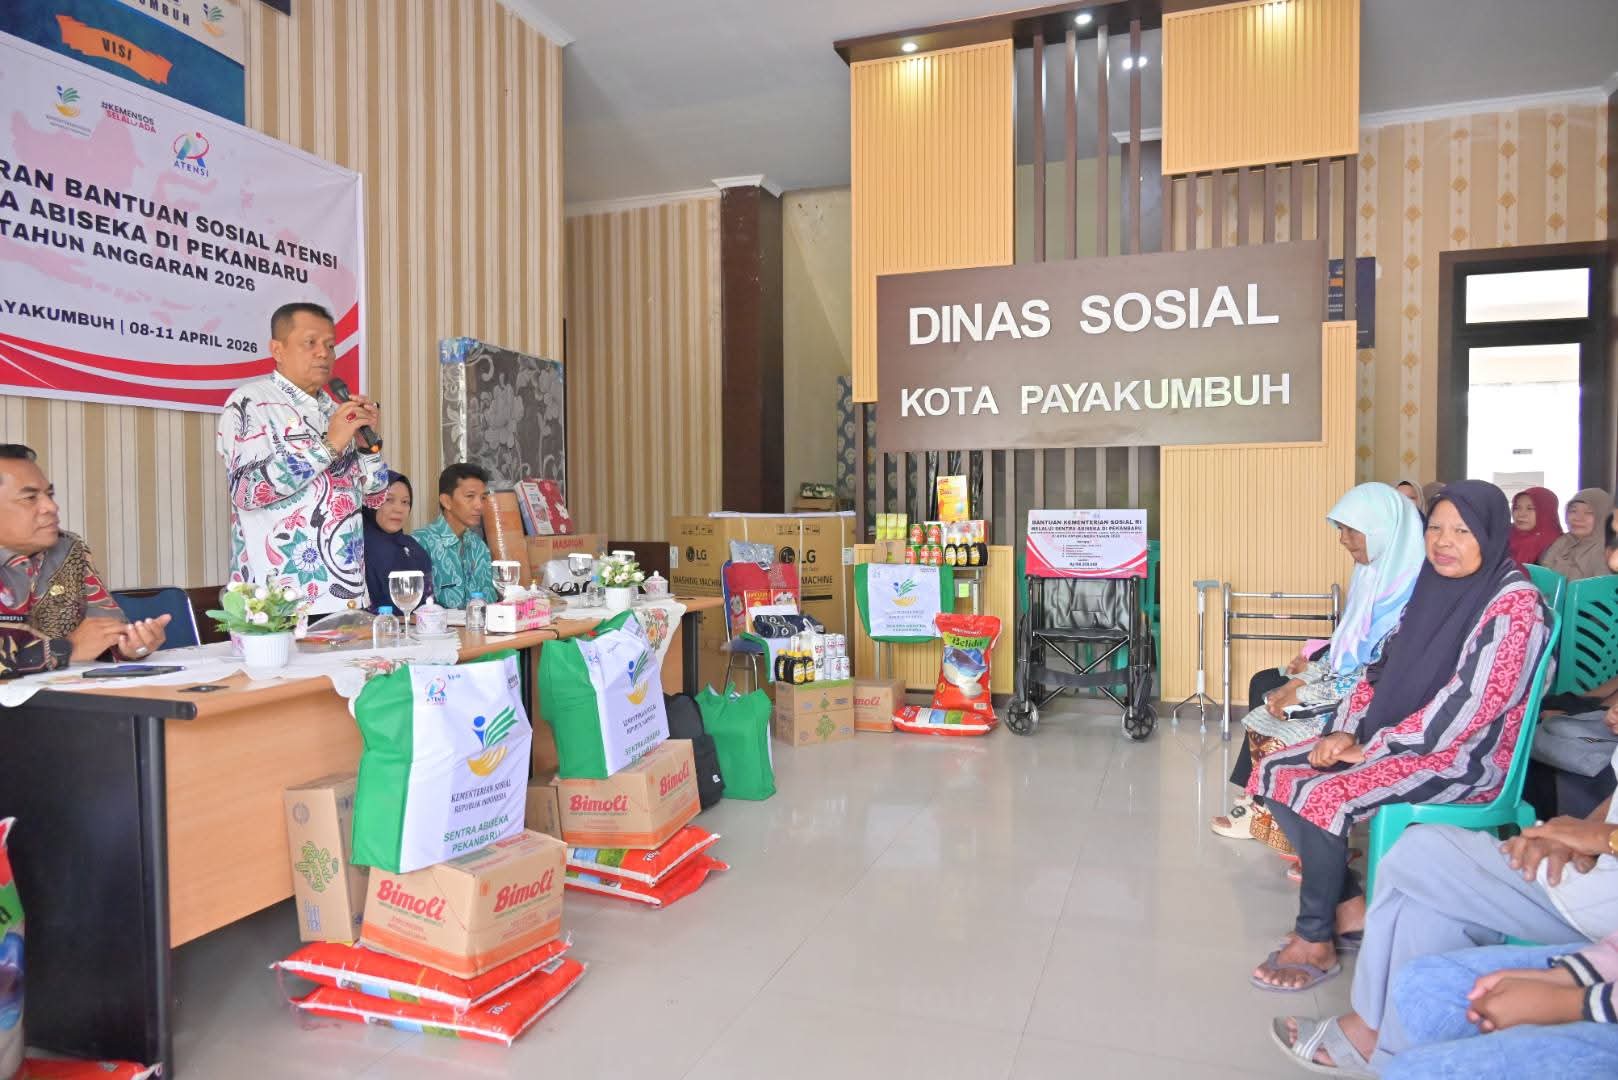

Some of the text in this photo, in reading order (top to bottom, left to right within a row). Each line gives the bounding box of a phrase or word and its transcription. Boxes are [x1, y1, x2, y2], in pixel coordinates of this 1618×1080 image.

[102, 37, 132, 61] VISI
[101, 101, 155, 125] #KEMENSOS
[138, 121, 157, 134] ADA
[173, 160, 209, 178] ATENSI
[0, 159, 338, 270] RAN BANTUAN SOSIAL ATENSI
[29, 198, 148, 244] ABISEKA
[155, 230, 179, 251] DI
[186, 238, 309, 284] PEKANBARU
[0, 218, 256, 292] TAHUN ANGGARAN 2026
[908, 283, 1280, 346] DINAS SOSIAL
[129, 321, 174, 340] 08-11
[178, 330, 223, 348] APRIL
[226, 338, 258, 354] 2026
[900, 372, 1291, 418] KOTA PAYAKUMBUH
[695, 549, 707, 560] LG
[798, 549, 816, 564] LG
[801, 575, 833, 585] MACHINE
[659, 759, 690, 796] Bimoli
[451, 785, 494, 803] KEMENTERIAN
[569, 794, 629, 812] Bimoli
[443, 825, 477, 842] SENTRA
[376, 879, 447, 921] Bimoli
[493, 868, 554, 912] Bimoli
